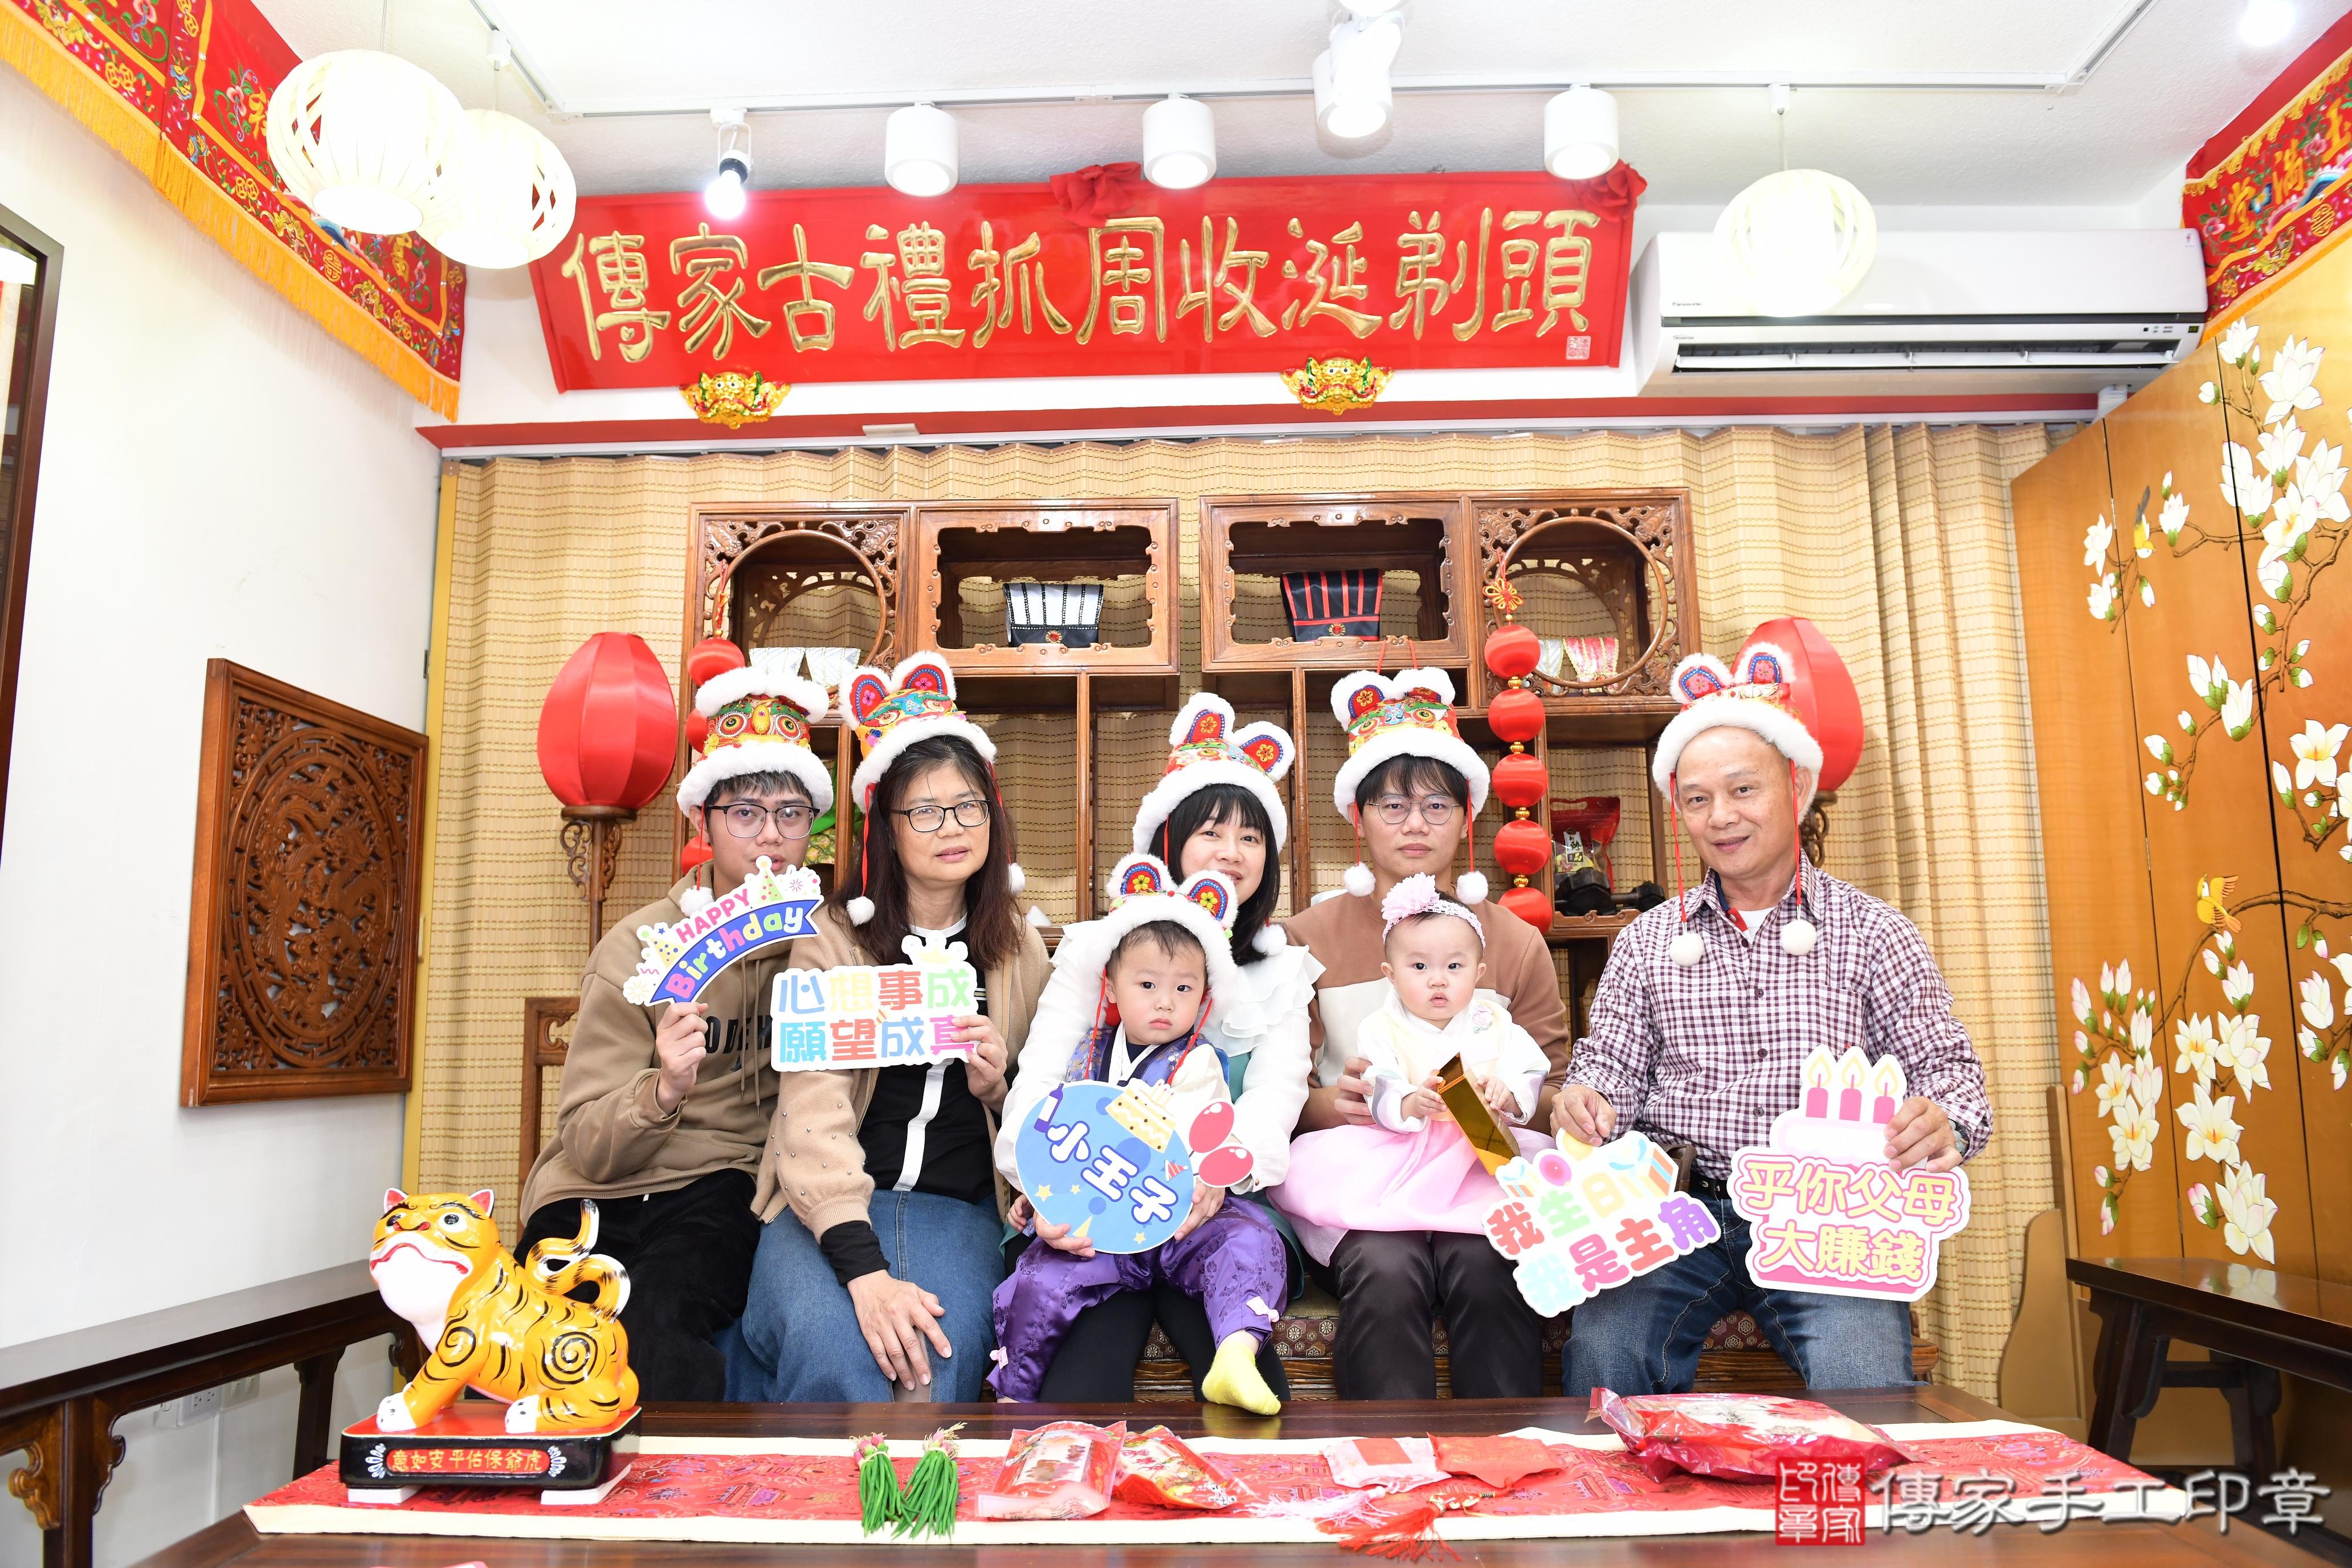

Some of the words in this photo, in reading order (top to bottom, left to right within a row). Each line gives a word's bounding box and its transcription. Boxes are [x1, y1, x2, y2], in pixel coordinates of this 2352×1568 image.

[563, 207, 1596, 363] 傳家古禮抓周收涎剃頭
[665, 906, 803, 999] Birthday
[676, 888, 750, 944] HAPPY
[778, 968, 971, 1014] 心想事成
[779, 1014, 975, 1063] 願望成真
[1045, 1120, 1179, 1224] 小王子
[1741, 1161, 1957, 1226] 乎你父母
[1486, 1171, 1626, 1255] 我生日
[1520, 1197, 1717, 1313] 我是主角
[1759, 1219, 1926, 1282] 大賺錢
